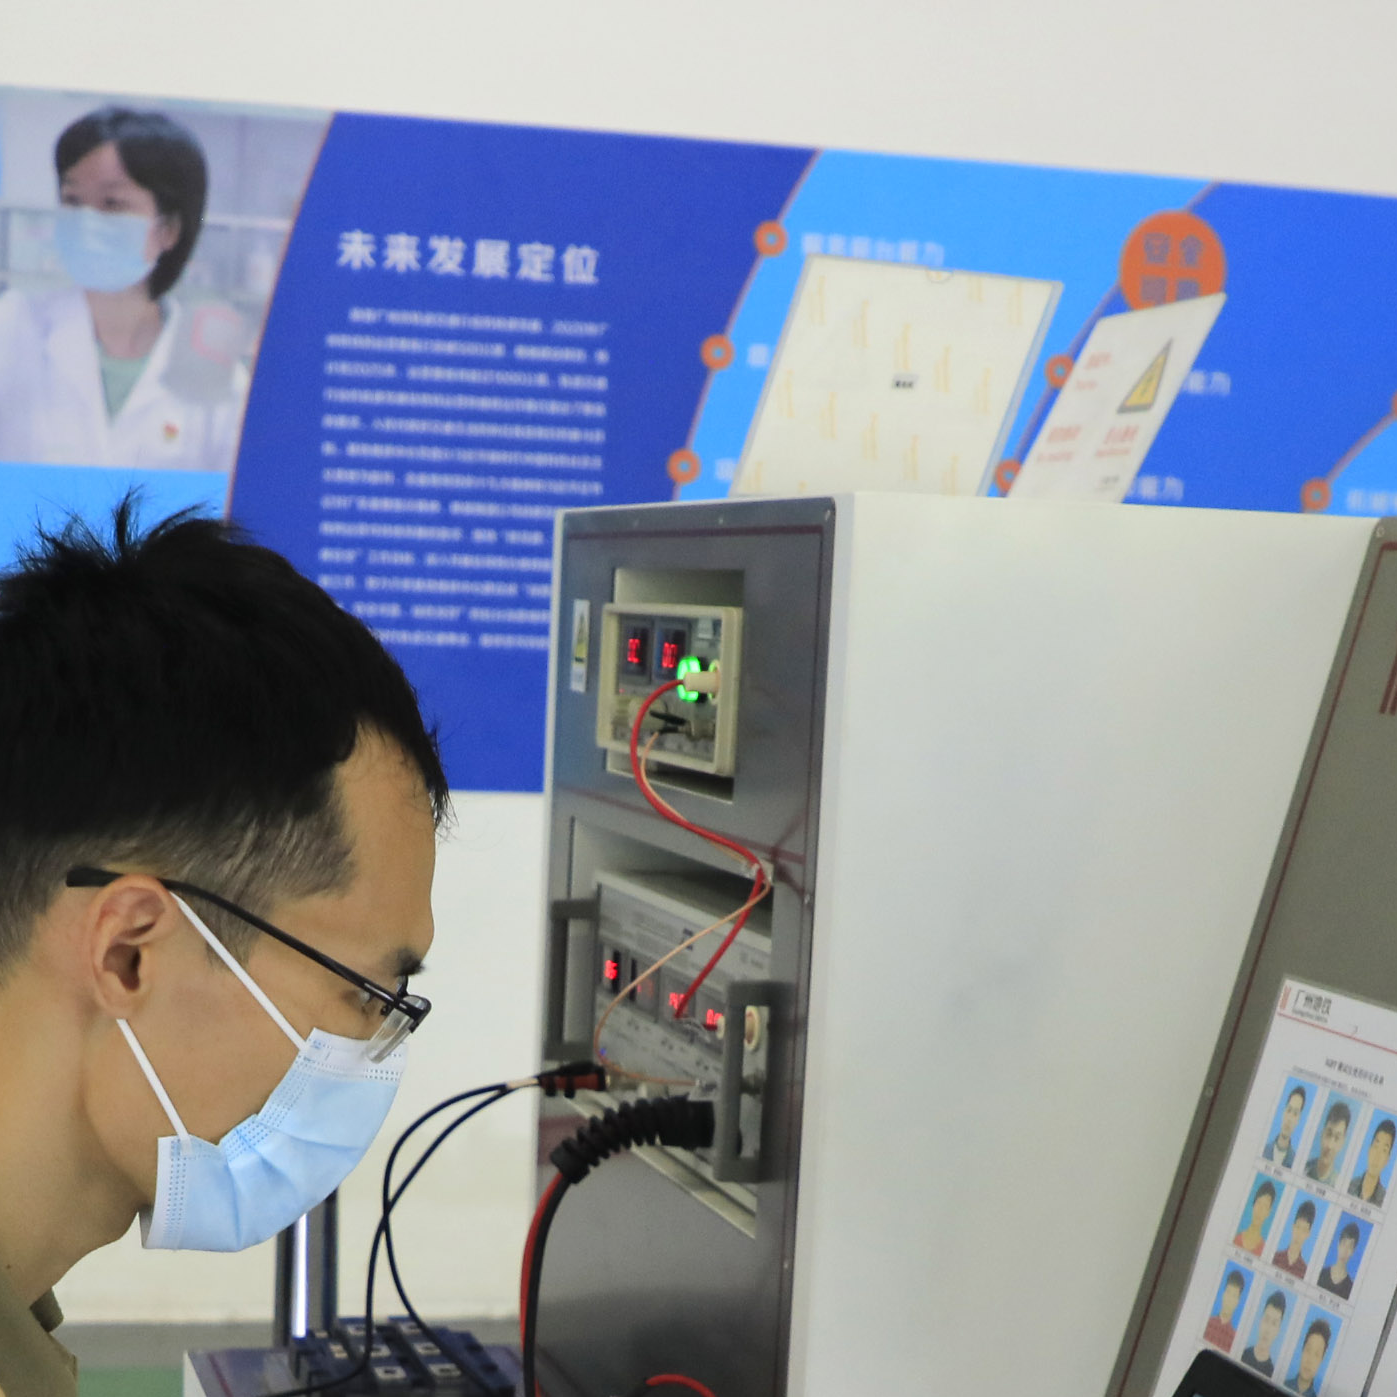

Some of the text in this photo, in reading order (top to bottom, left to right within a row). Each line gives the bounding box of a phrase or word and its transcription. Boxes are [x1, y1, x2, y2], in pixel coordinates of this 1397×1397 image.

[336, 229, 600, 285] 未来发展定位
